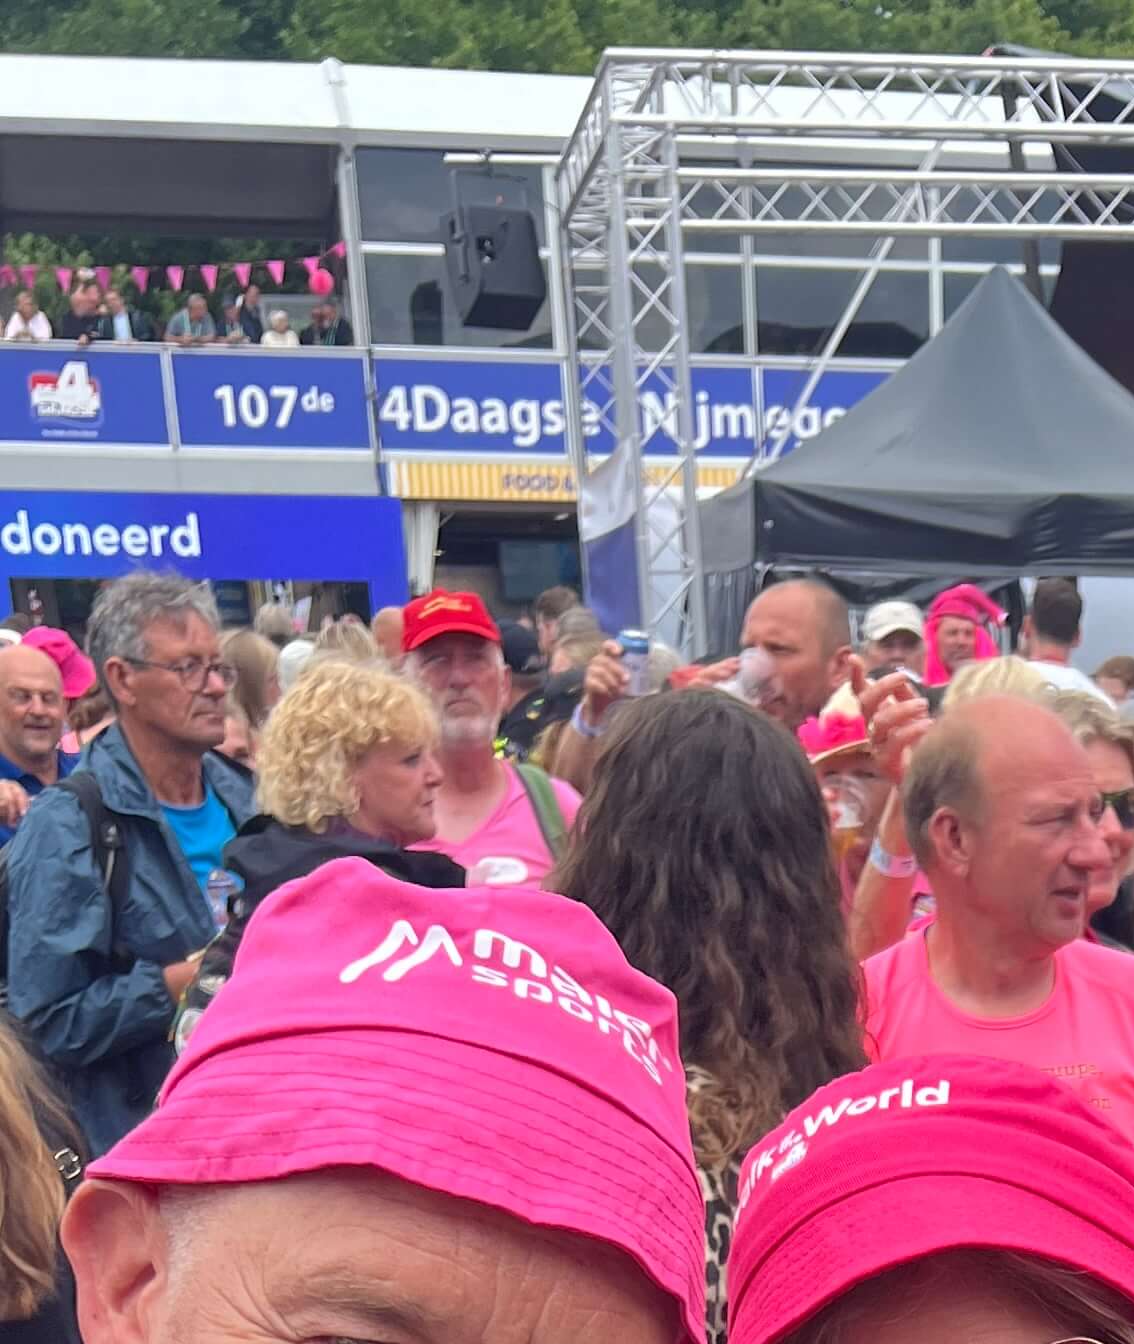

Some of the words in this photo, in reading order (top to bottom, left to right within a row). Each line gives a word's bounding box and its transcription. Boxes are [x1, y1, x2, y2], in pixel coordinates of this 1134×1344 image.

[503, 473, 559, 491] FOOD
[1, 510, 202, 557] doneerd
[803, 1079, 950, 1137] World
